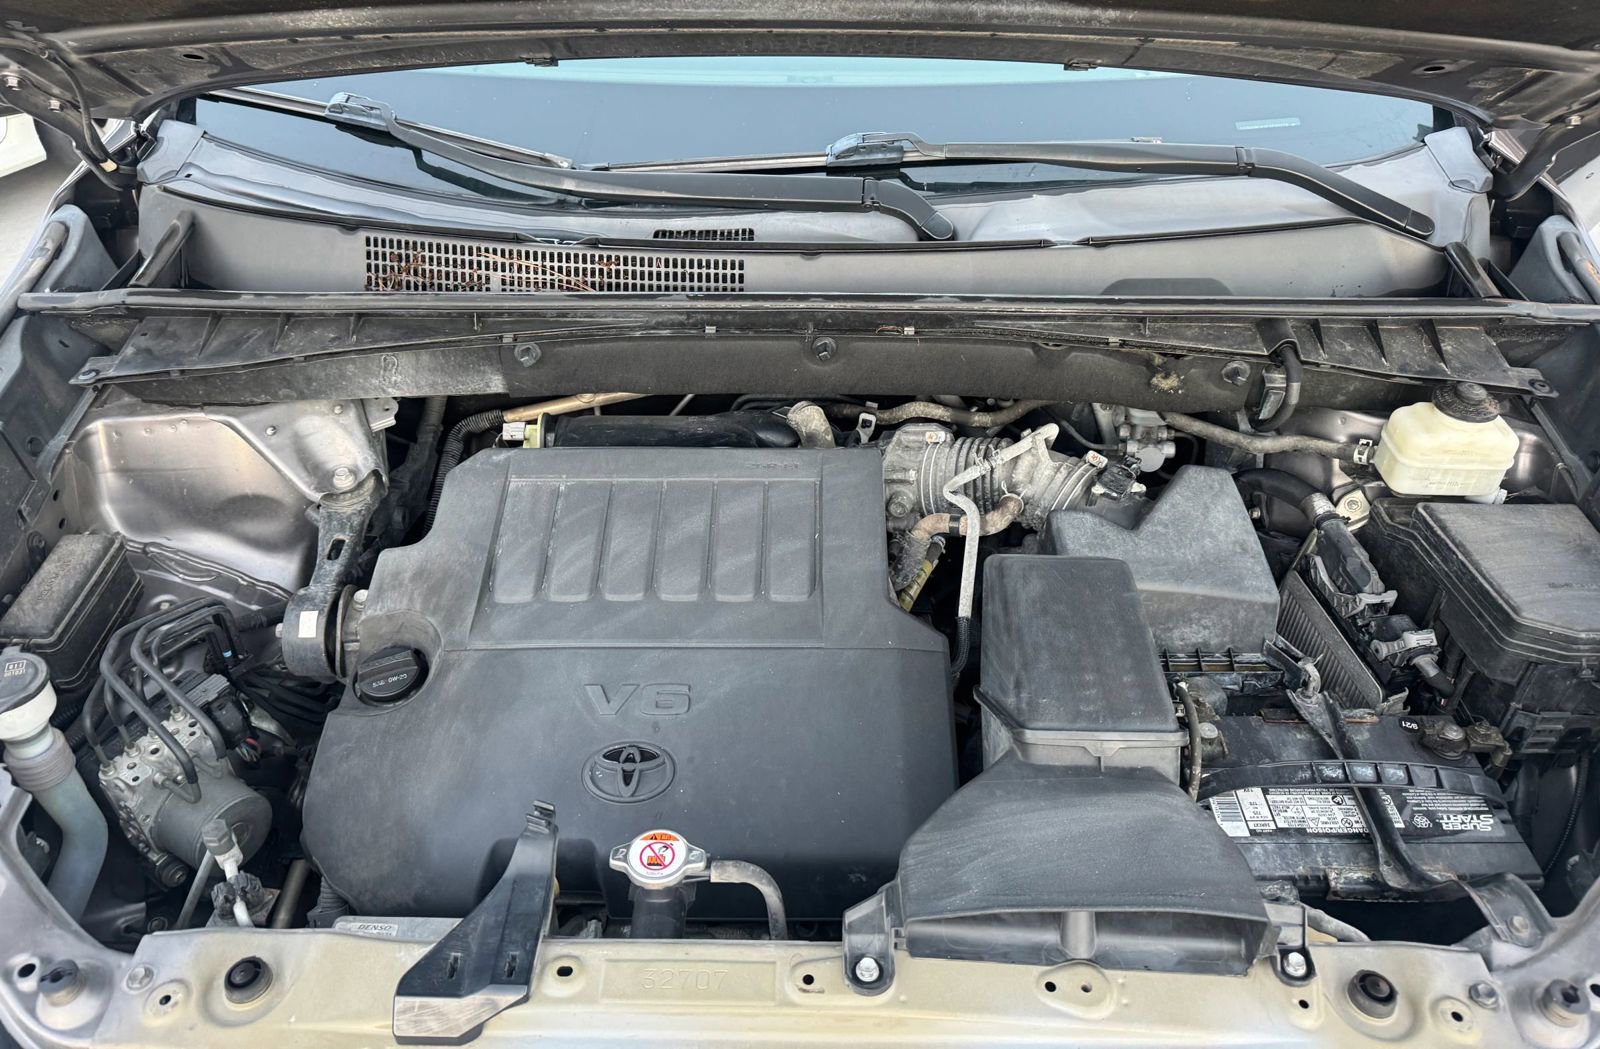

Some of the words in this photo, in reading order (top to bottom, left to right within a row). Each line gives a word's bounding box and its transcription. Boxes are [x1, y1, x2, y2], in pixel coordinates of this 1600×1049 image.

[584, 682, 691, 715] V6
[1440, 814, 1494, 823] START
[1441, 822, 1492, 831] SUPER
[641, 968, 729, 990] 32707
